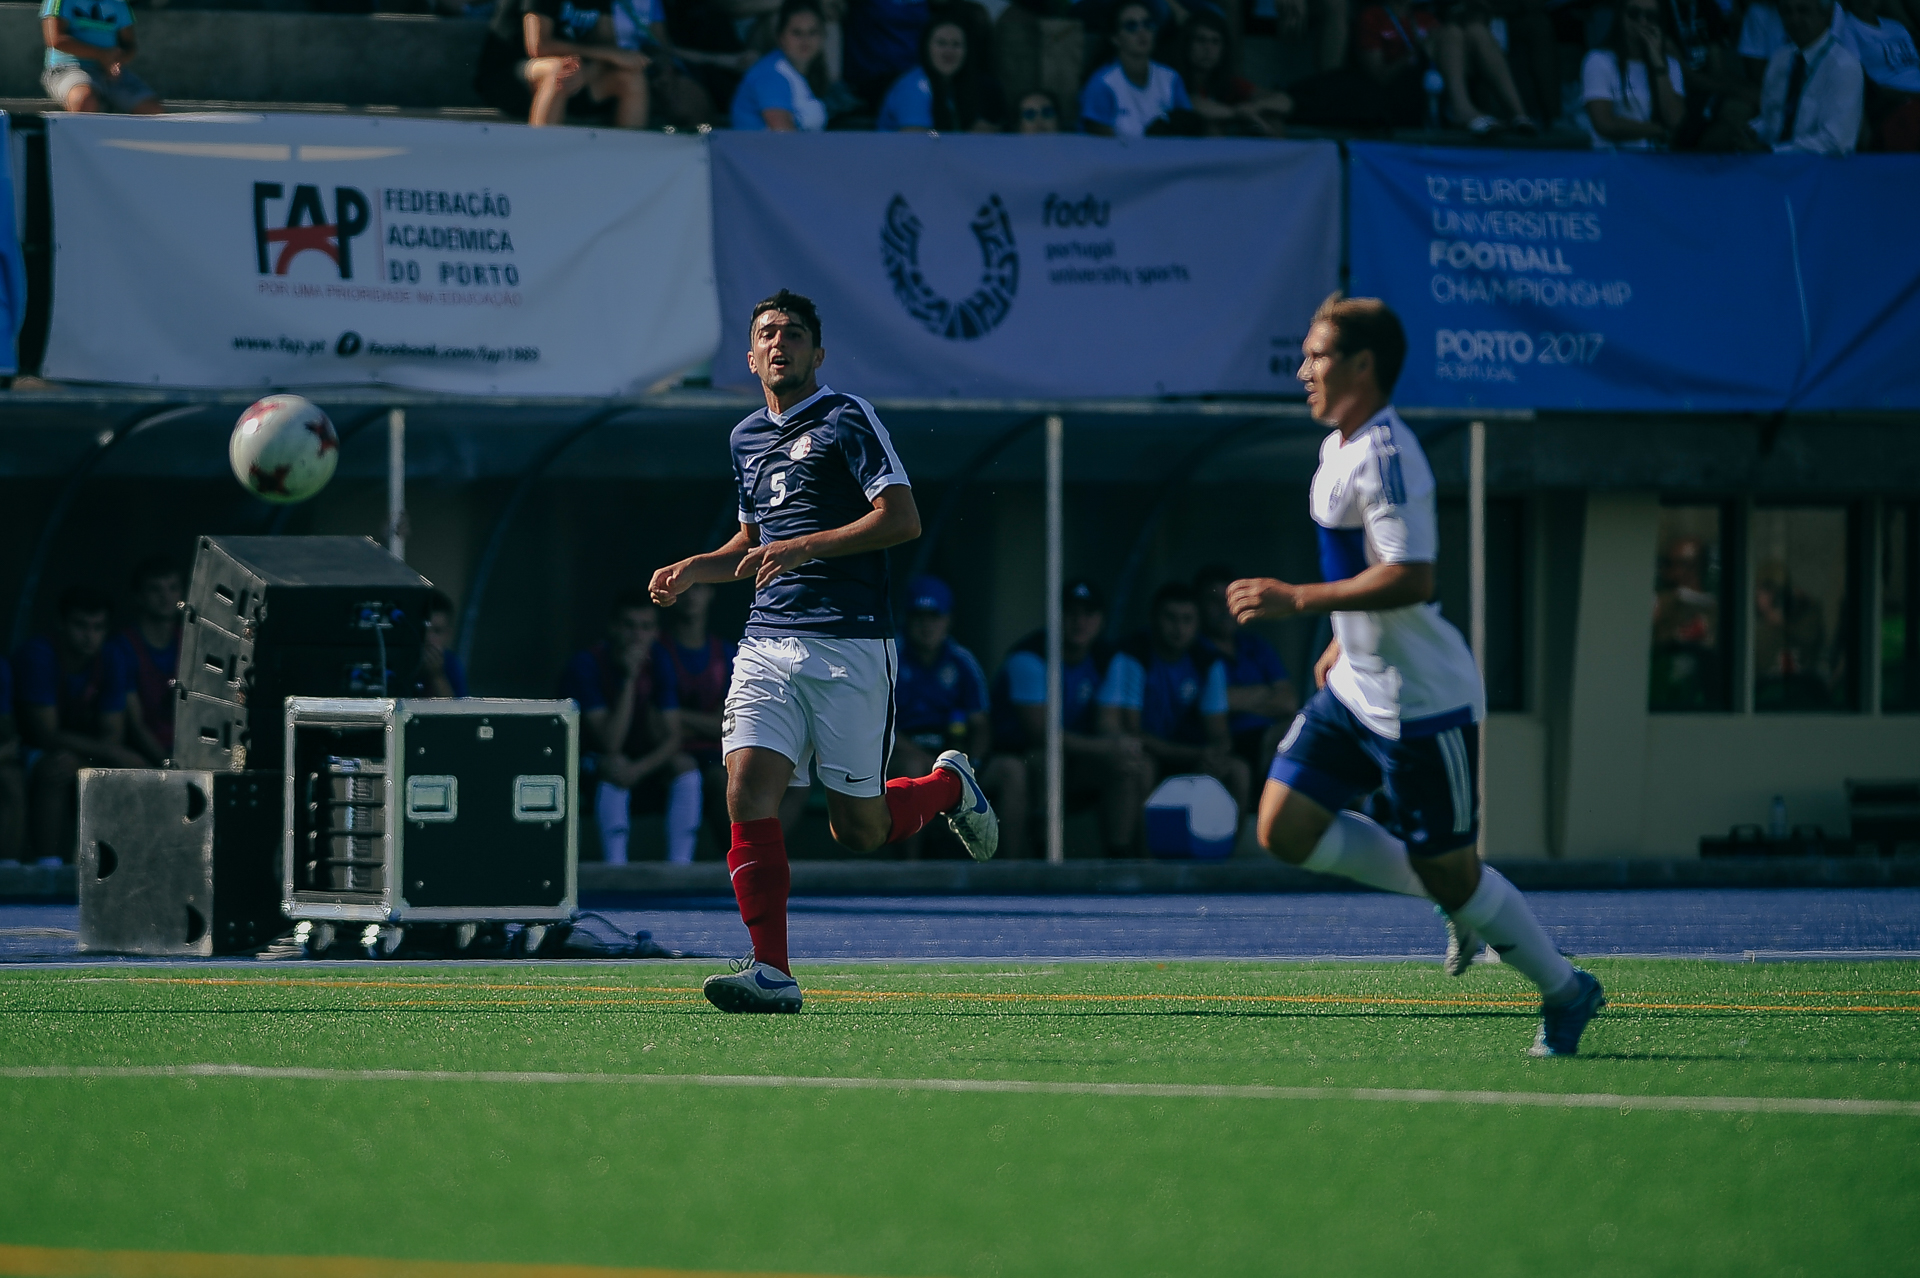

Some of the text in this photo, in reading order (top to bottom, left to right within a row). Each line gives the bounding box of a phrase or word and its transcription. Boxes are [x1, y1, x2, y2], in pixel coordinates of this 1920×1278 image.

[1461, 177, 1607, 207] EUROPEAN
[253, 180, 373, 280] FAP
[1432, 208, 1602, 241] UNIVERSITIES
[389, 259, 520, 287] DO PORTO
[1429, 239, 1573, 275] FOOTBALL
[1430, 272, 1633, 308] CHAMPIONSHIP
[1435, 328, 1604, 364] PORTO 2017
[769, 471, 787, 507] 5
